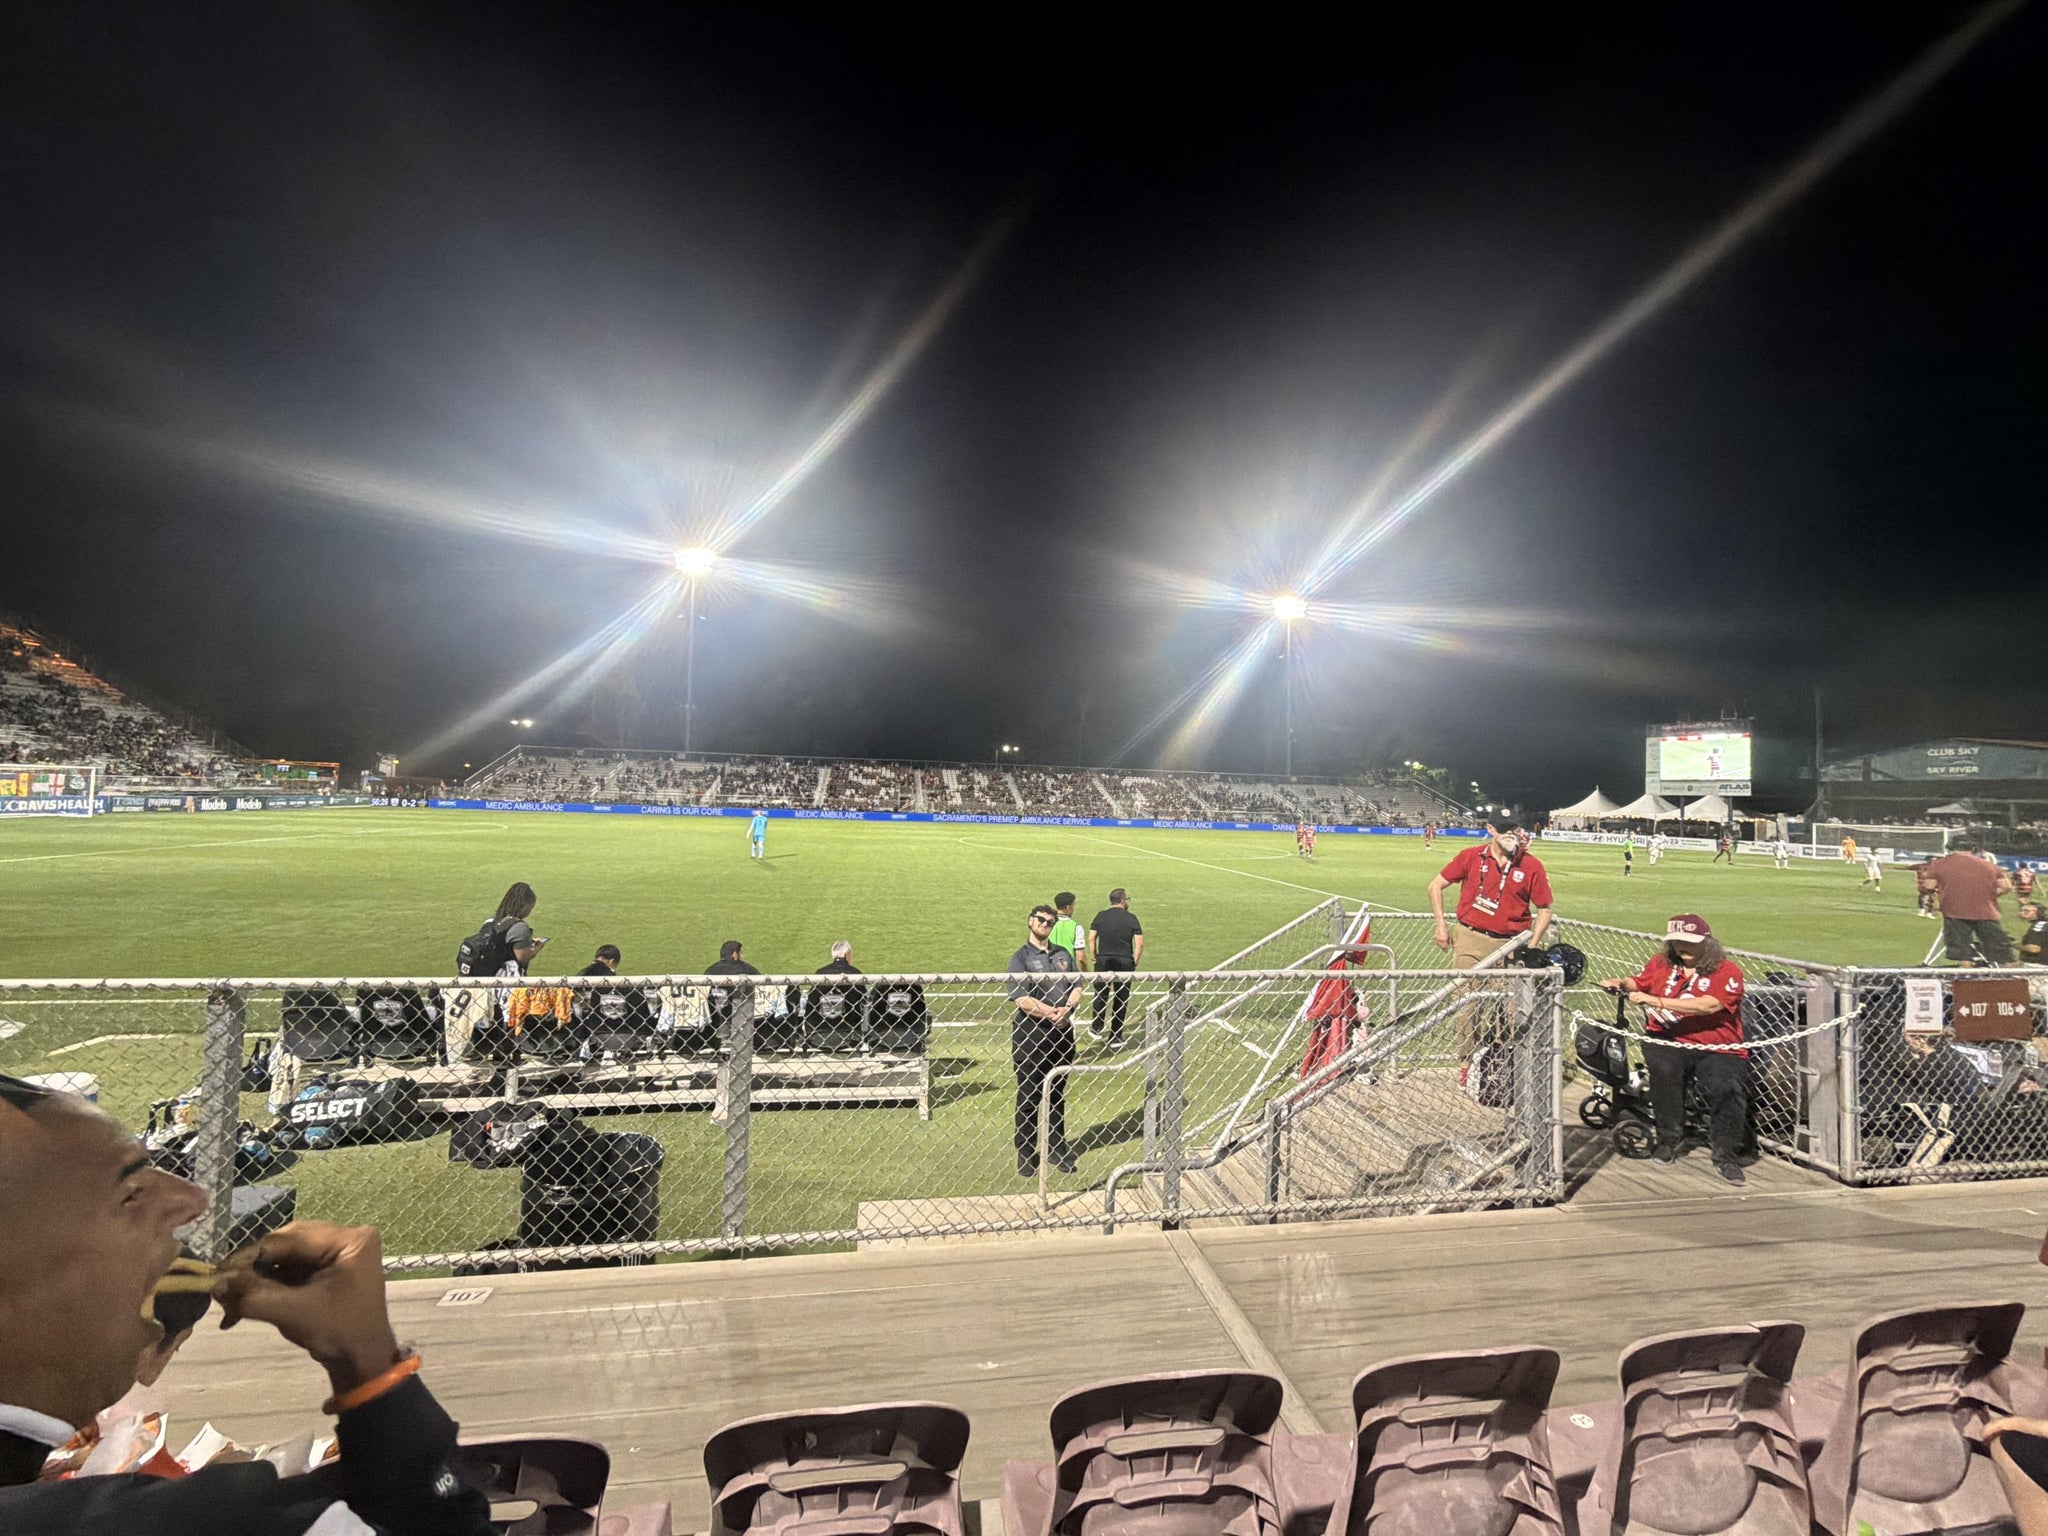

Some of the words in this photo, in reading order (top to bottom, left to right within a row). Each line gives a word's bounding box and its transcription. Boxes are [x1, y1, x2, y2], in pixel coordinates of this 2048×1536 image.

[201, 798, 228, 811] Modelo
[236, 798, 263, 810] Modelo
[485, 802, 512, 810] MEDIC
[513, 803, 564, 811] AMBULANCE
[640, 806, 671, 815] CARING
[672, 807, 680, 815] IS
[700, 808, 723, 816] CORE
[819, 811, 865, 819] AMBULANCE
[932, 814, 987, 823] SACRAMENTO'S
[1062, 817, 1091, 826] SERVICE
[1153, 820, 1173, 828] MEDIC
[1174, 821, 1213, 829] AMBULANCE
[1319, 825, 1336, 833] CORE
[1391, 827, 1410, 835] MEDIC
[1971, 1002, 1988, 1017] 107
[1996, 1001, 2015, 1016] 106
[290, 1097, 368, 1124] SELECT
[448, 1291, 487, 1302] 107
